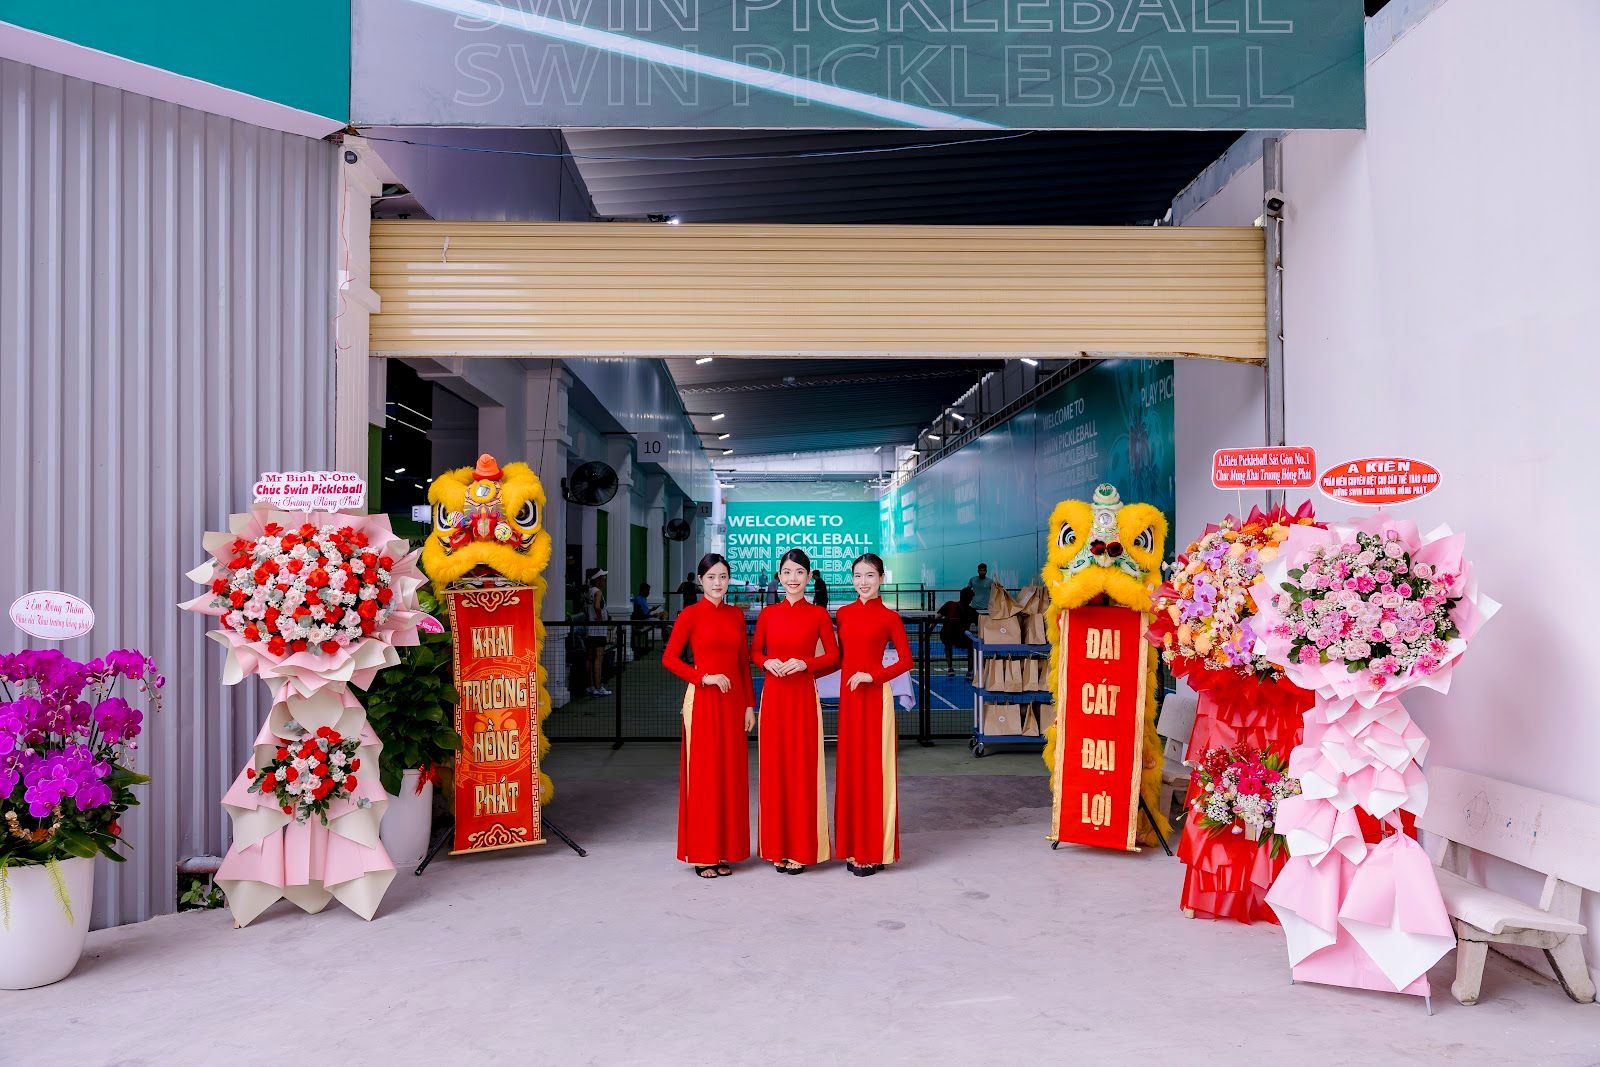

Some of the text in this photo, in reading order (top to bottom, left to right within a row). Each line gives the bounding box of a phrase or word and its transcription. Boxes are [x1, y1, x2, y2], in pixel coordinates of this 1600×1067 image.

[453, 43, 1295, 108] SWIN PICKLEBALL
[1043, 398, 1085, 430] WELCOME TO
[1058, 420, 1098, 450] PICKLEBALL
[644, 440, 661, 454] 10
[1239, 453, 1268, 466] Pickleball
[1295, 452, 1310, 464] No.1
[1347, 464, 1359, 473] A
[265, 474, 283, 482] Mr
[319, 473, 356, 482] N-One
[1246, 468, 1260, 480] Khai
[256, 483, 363, 495] Chúc Swin Pickleball
[728, 515, 844, 527] WELCOME TO
[728, 533, 873, 545] SWIN PICKLEBALL
[728, 546, 771, 559] SWIN
[729, 559, 771, 573] SWIN
[471, 626, 514, 659] KHAI
[1086, 628, 1121, 664] ĐẠI
[1081, 678, 1121, 716] CÁT
[472, 717, 521, 763] HỒNG
[1081, 738, 1116, 775] ĐẠI
[474, 775, 519, 817] PHÁT
[1081, 790, 1112, 831] LỢI
